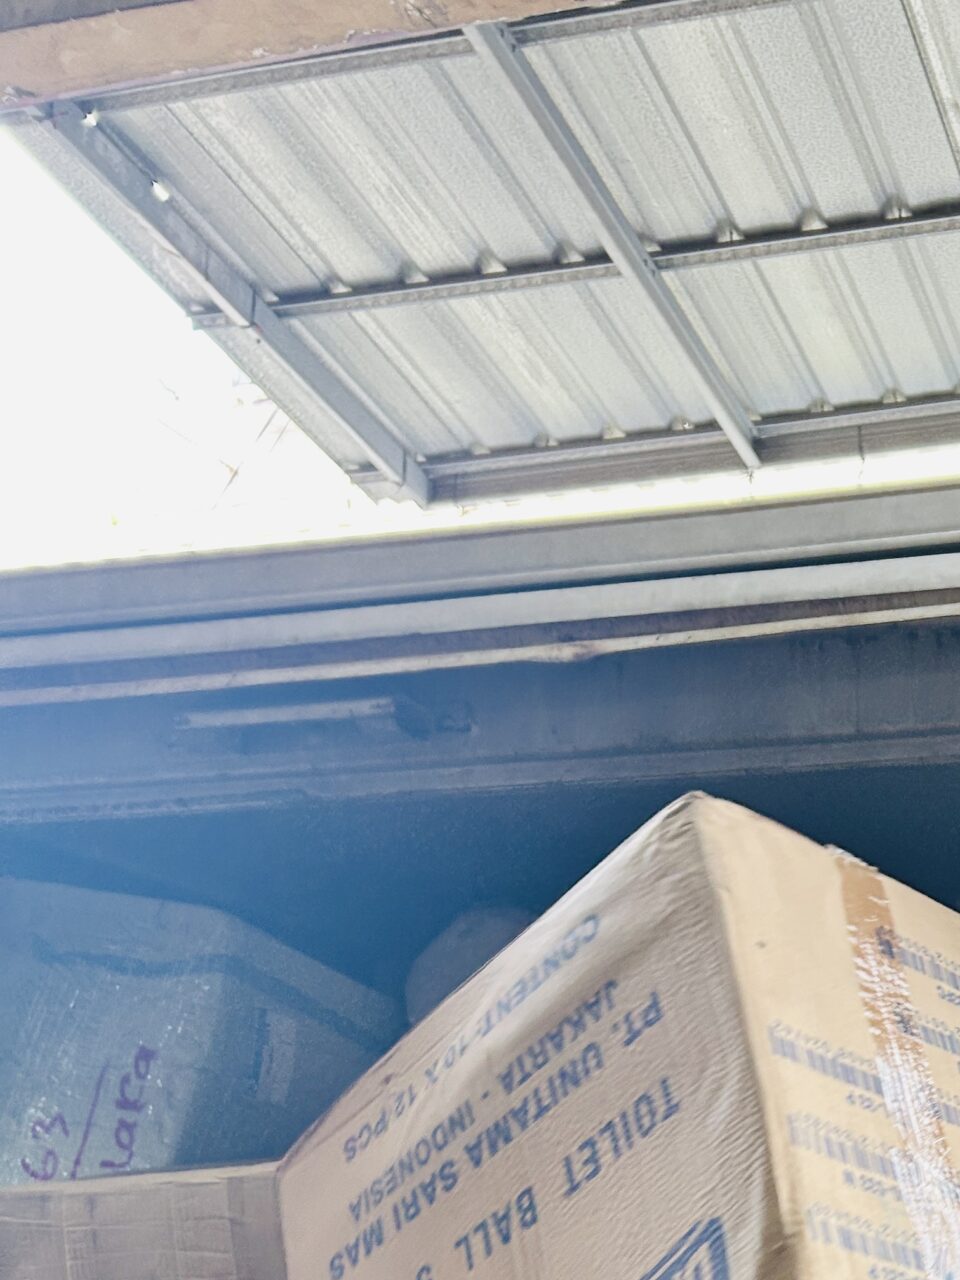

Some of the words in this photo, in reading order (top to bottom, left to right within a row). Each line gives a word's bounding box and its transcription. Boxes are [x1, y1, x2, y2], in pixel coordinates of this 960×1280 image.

[498, 980, 619, 1095] JAKARTA
[611, 991, 665, 1048] PT.
[349, 1099, 476, 1223] INDONESIA
[463, 1041, 604, 1168] UNITAMA
[562, 1077, 682, 1198] TOILET
[393, 1160, 459, 1232] SARI
[453, 1185, 539, 1272] BALL
